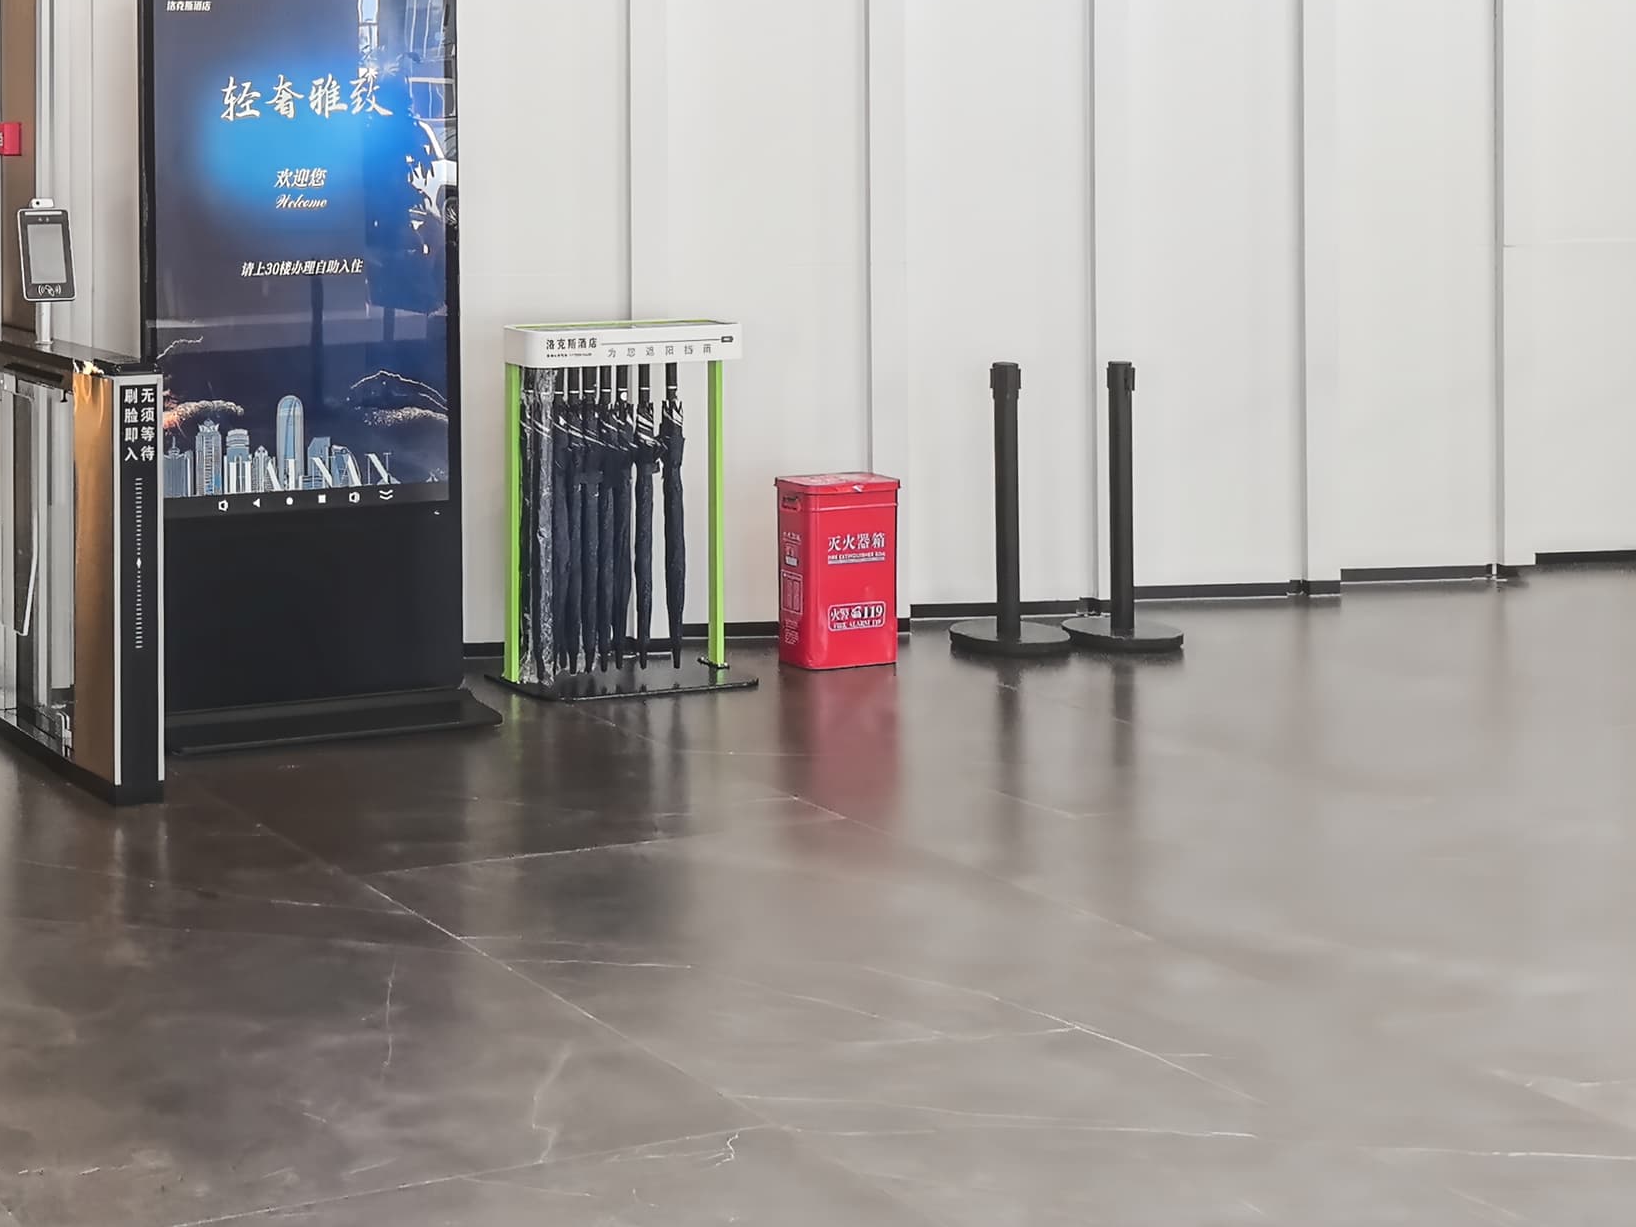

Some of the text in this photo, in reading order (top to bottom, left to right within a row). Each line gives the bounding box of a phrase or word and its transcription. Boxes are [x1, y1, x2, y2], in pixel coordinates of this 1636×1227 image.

[220, 72, 393, 122] 轻奢雅致
[274, 167, 327, 188] 欢迎您
[275, 194, 327, 209] Welcome
[240, 258, 363, 276] 请上30楼办理自助入住
[546, 338, 597, 350] 洛克斯酒店
[124, 388, 138, 462] 刷脸即入
[140, 388, 155, 462] 无须等待
[827, 532, 885, 553] 灭火器箱
[831, 605, 883, 621] 火警 119
